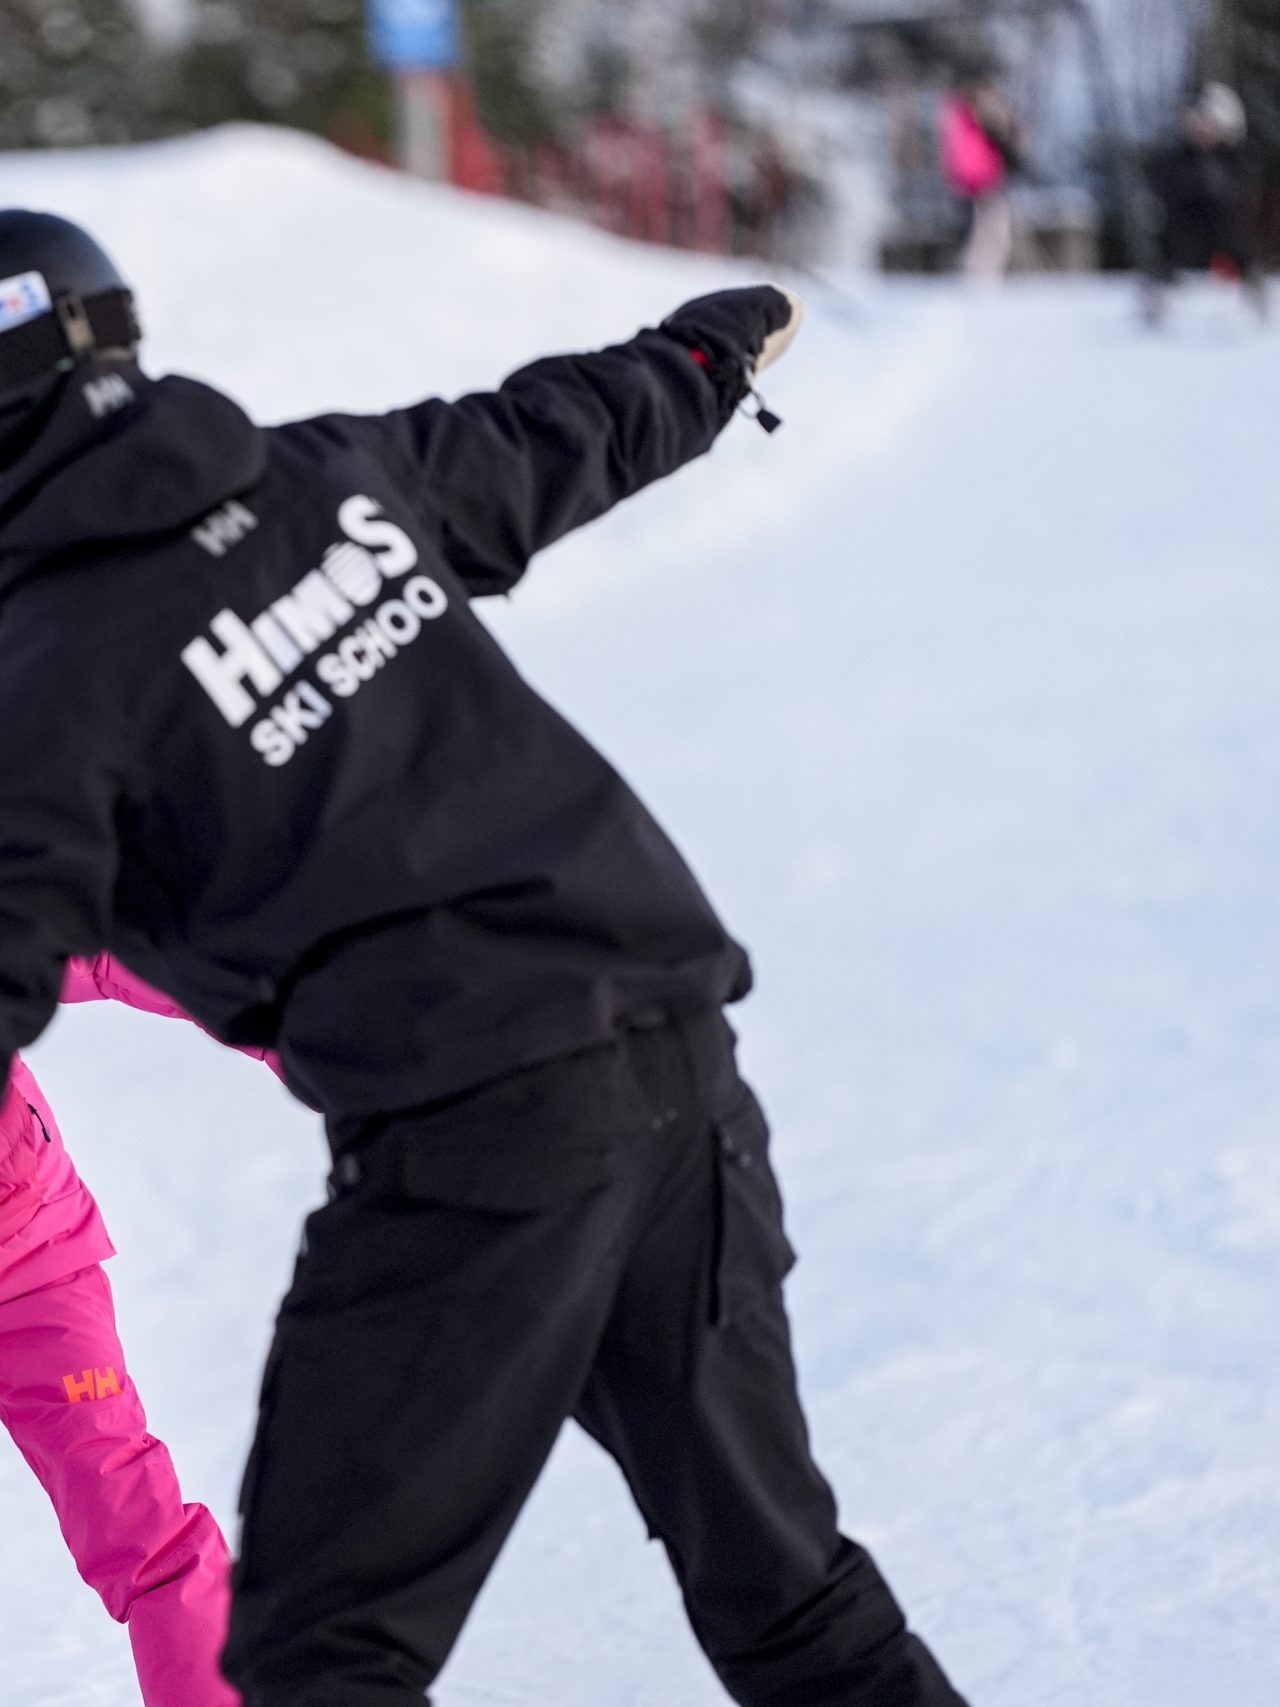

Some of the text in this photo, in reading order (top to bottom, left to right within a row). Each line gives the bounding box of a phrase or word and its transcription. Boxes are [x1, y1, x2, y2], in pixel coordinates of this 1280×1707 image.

[250, 574, 449, 767] SKI SCHOO
[62, 1366, 122, 1404] HH
